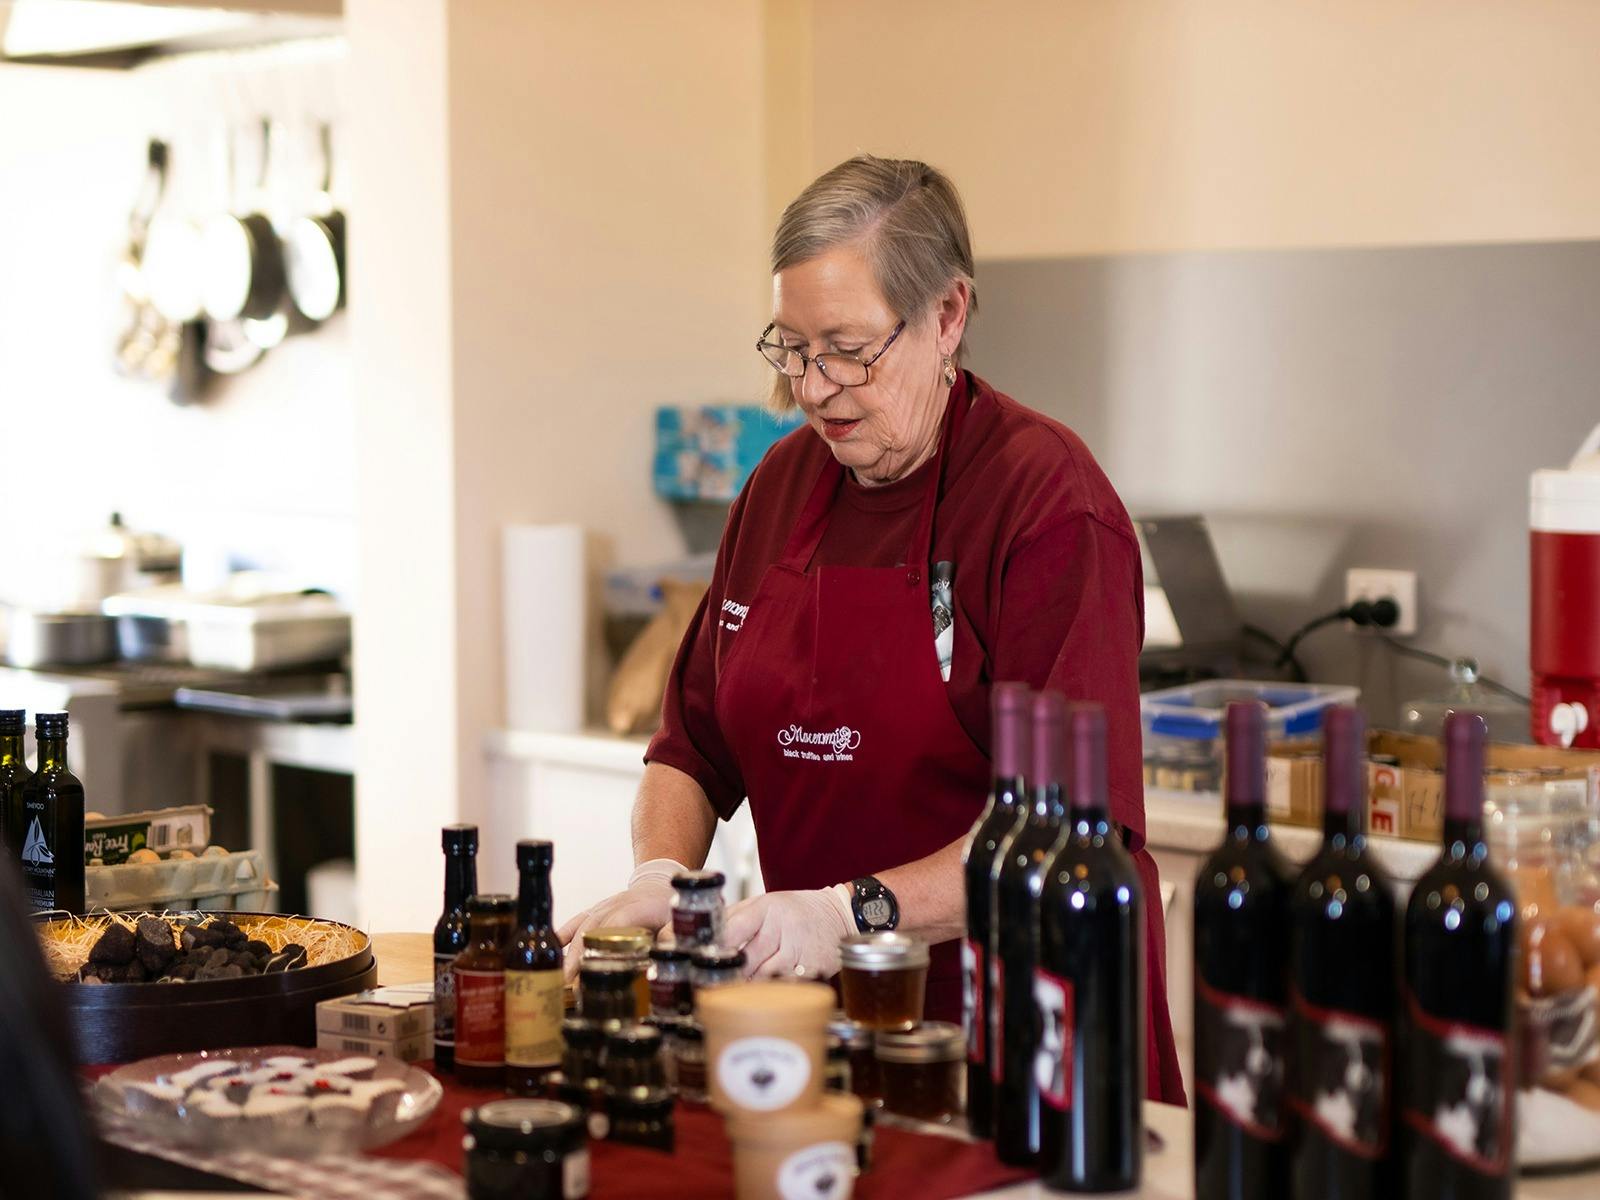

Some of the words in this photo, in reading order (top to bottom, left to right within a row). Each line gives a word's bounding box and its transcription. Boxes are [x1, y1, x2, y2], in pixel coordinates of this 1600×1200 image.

[783, 748, 800, 758] black
[822, 753, 835, 761] and
[104, 833, 129, 854] Free
